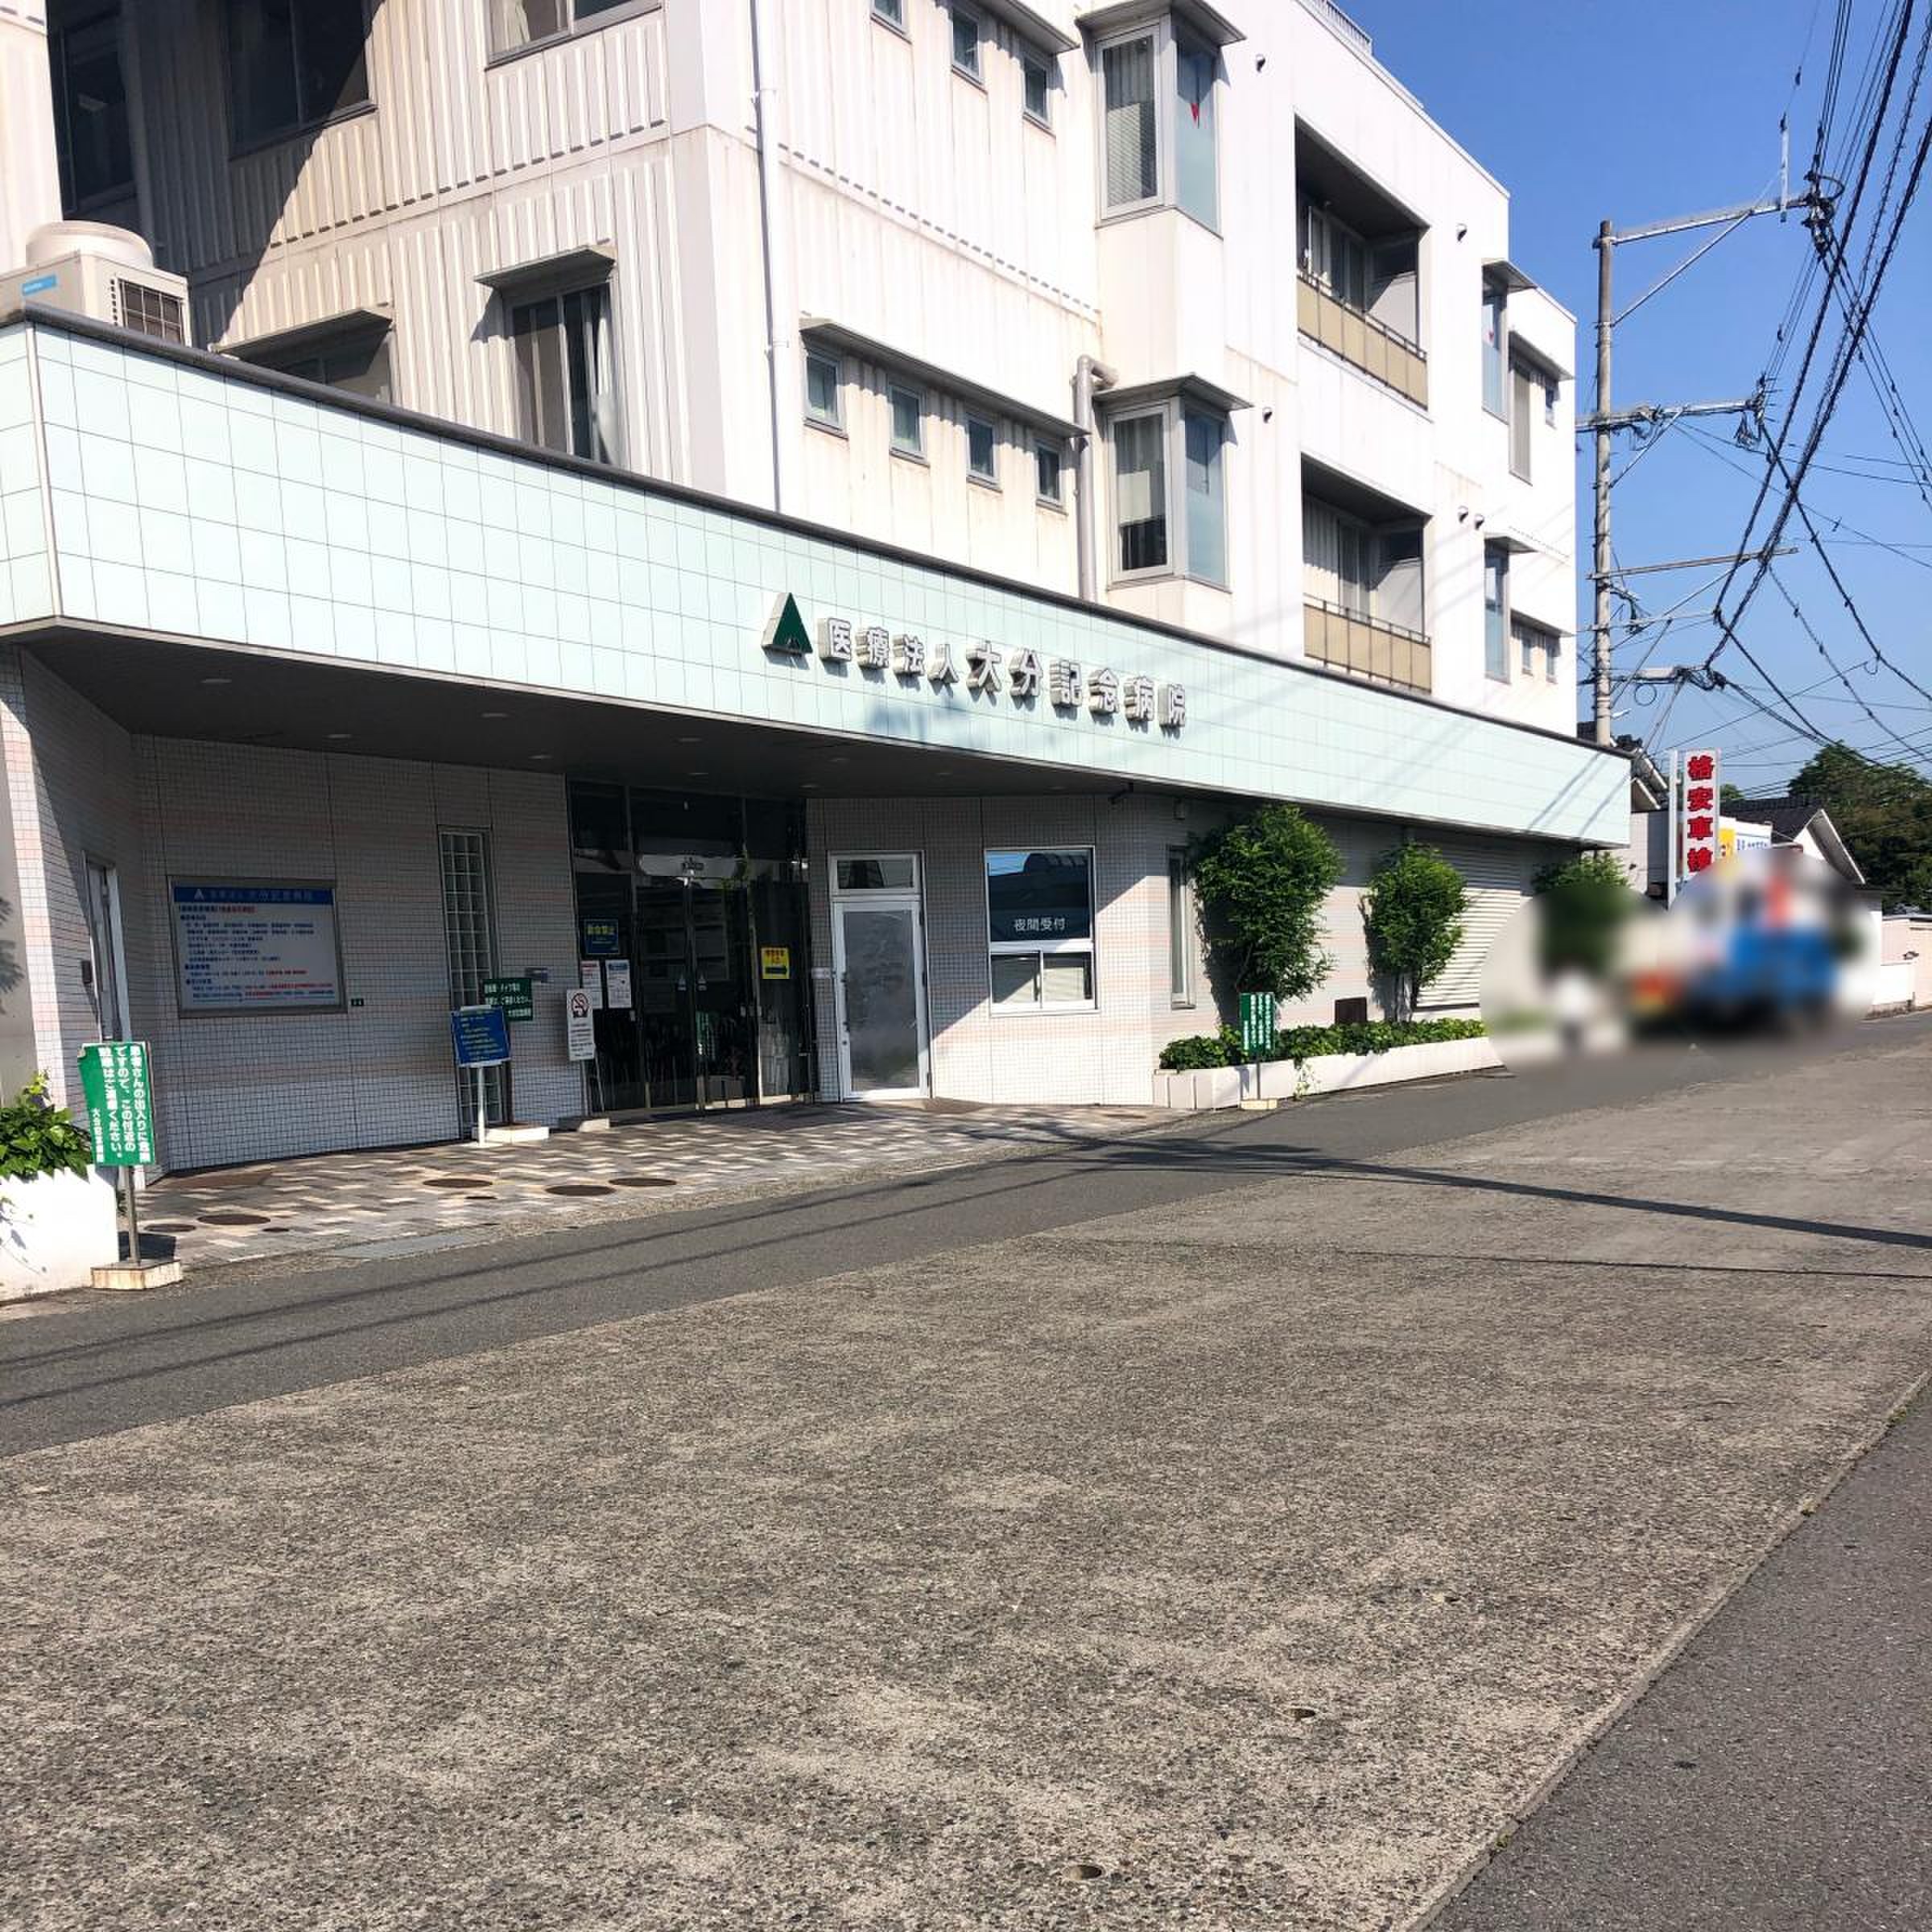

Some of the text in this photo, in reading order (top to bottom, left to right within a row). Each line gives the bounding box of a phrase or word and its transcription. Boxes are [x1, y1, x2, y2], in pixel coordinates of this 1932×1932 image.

[818, 617, 1186, 727] 医療法人大分記念病院
[1686, 754, 1715, 873] 格安車検
[1015, 917, 1066, 932] 夜間受付
